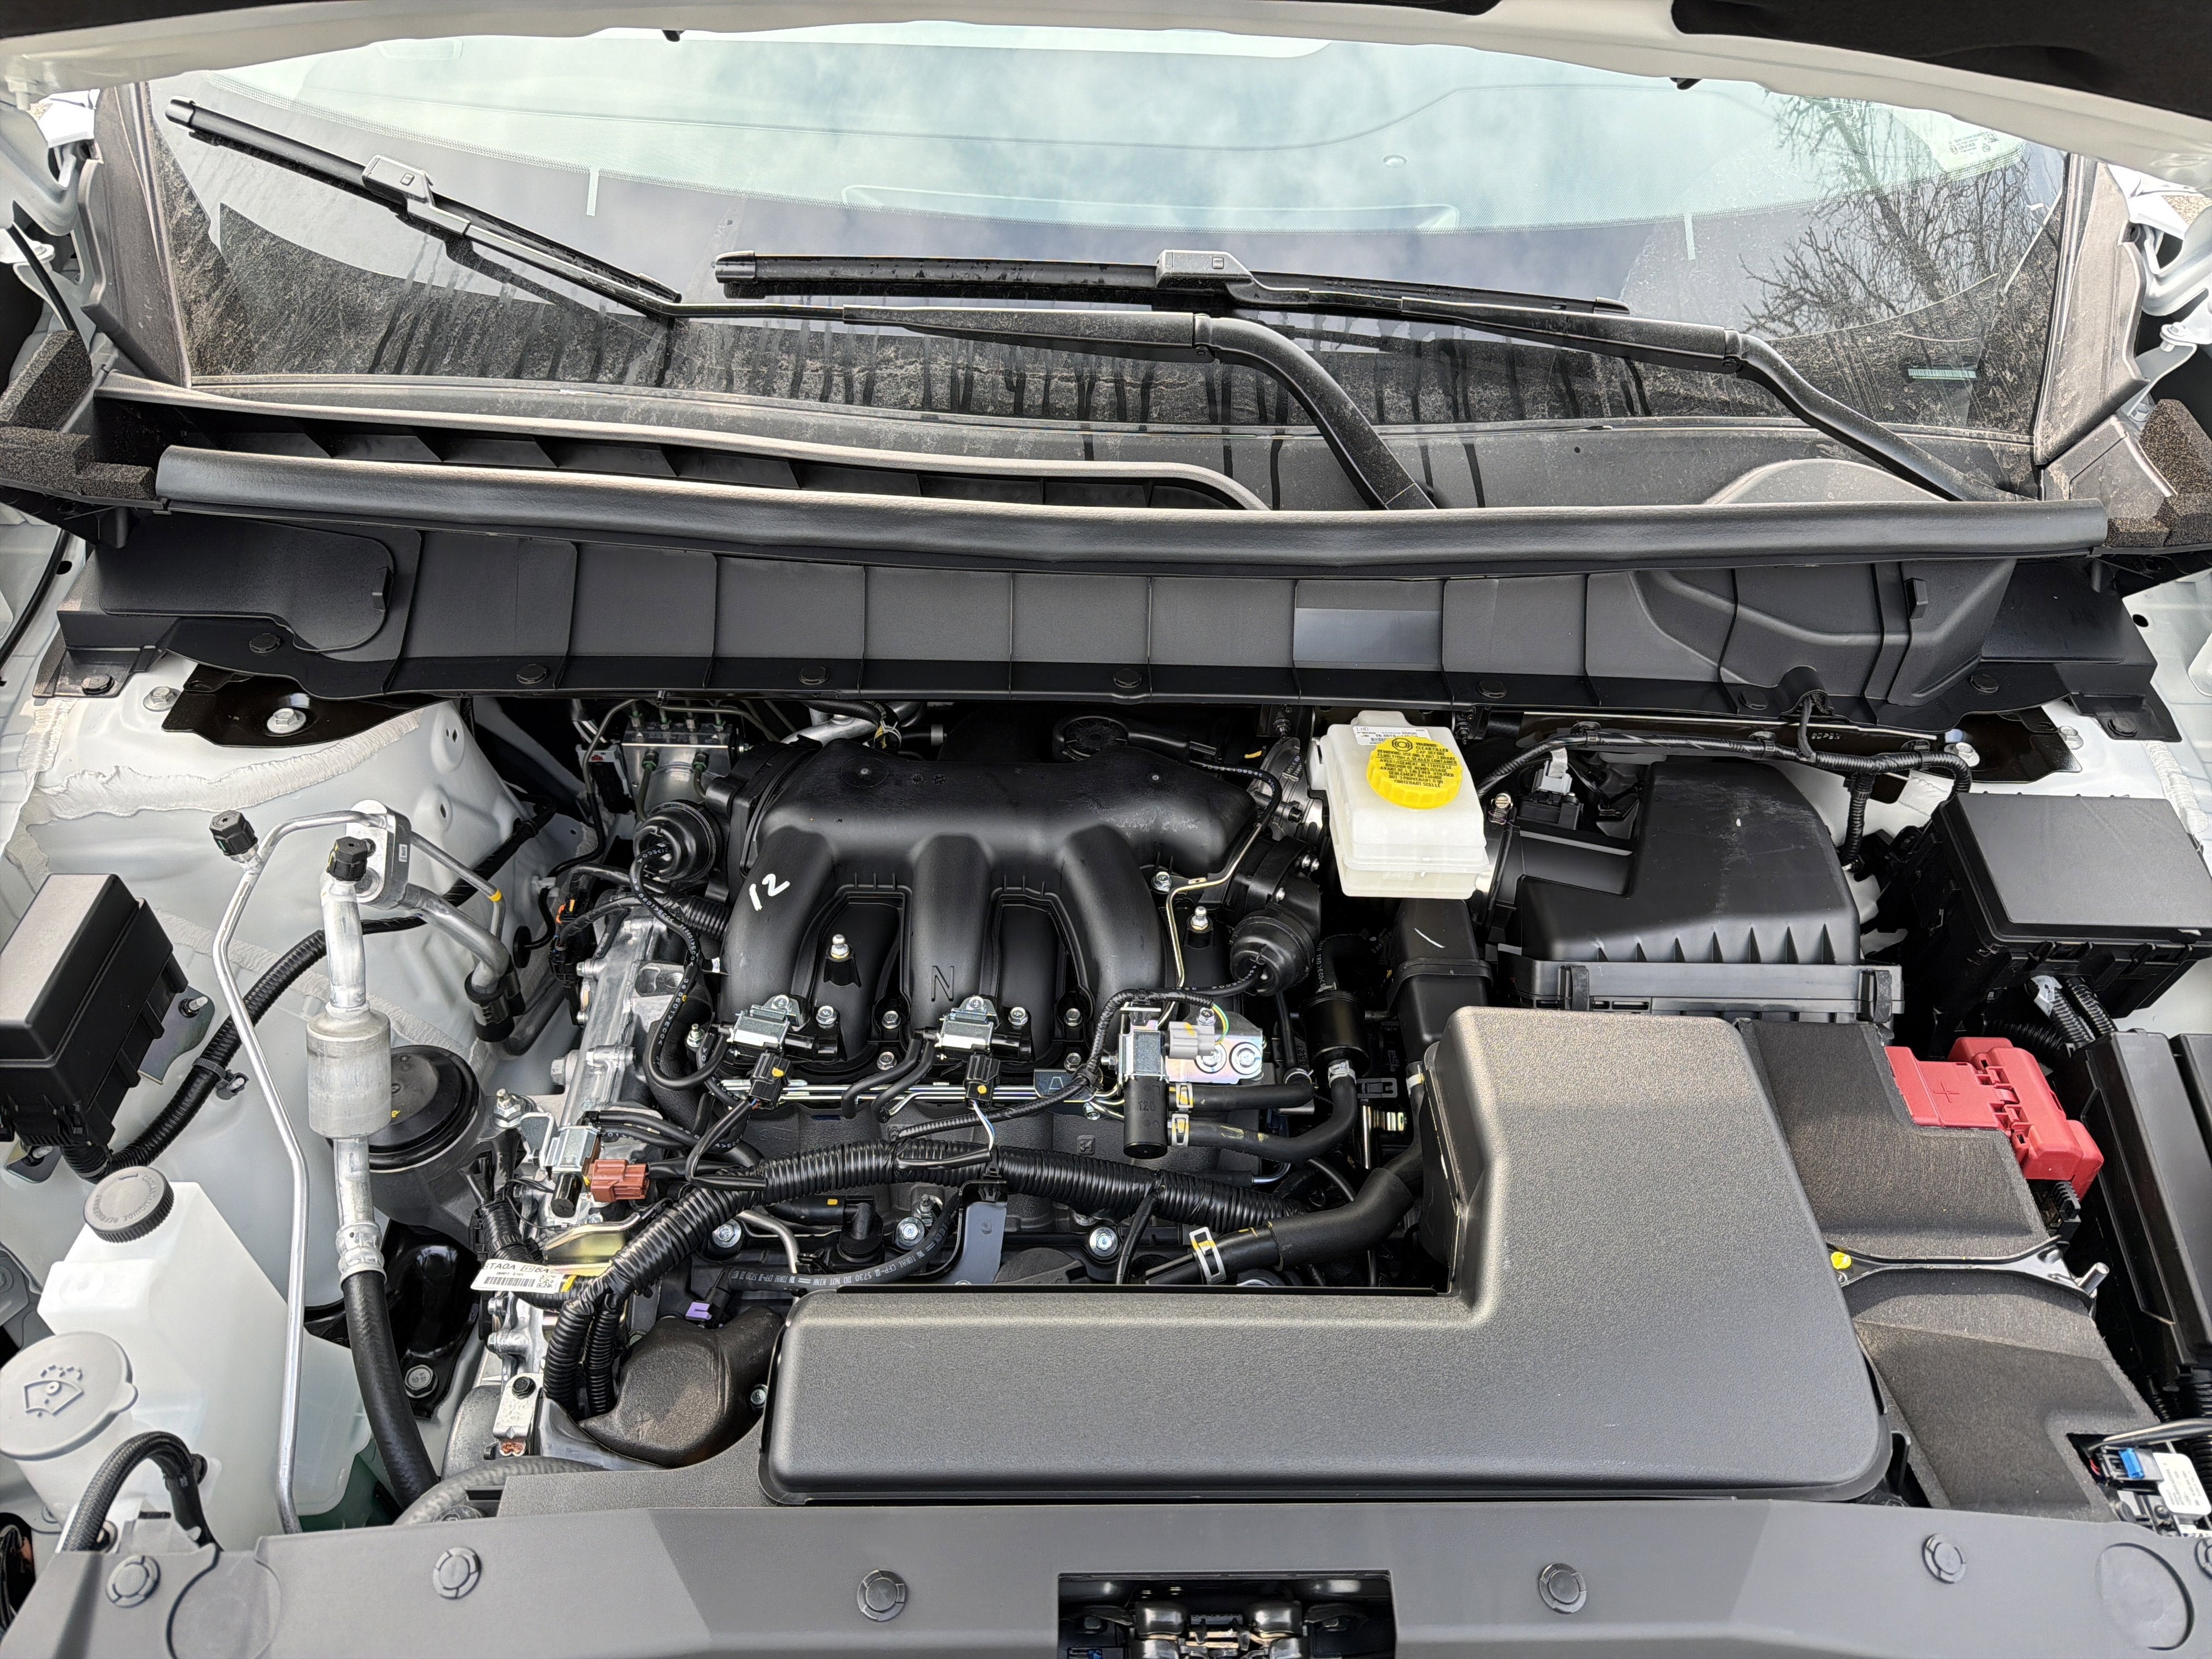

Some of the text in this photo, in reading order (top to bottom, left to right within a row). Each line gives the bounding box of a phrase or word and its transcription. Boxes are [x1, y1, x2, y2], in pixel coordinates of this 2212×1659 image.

[749, 873, 791, 912] 12
[1138, 1101, 1156, 1111] 120
[830, 1277, 840, 1285] NOT
[843, 1276, 852, 1284] DO
[855, 1271, 872, 1282] 5730
